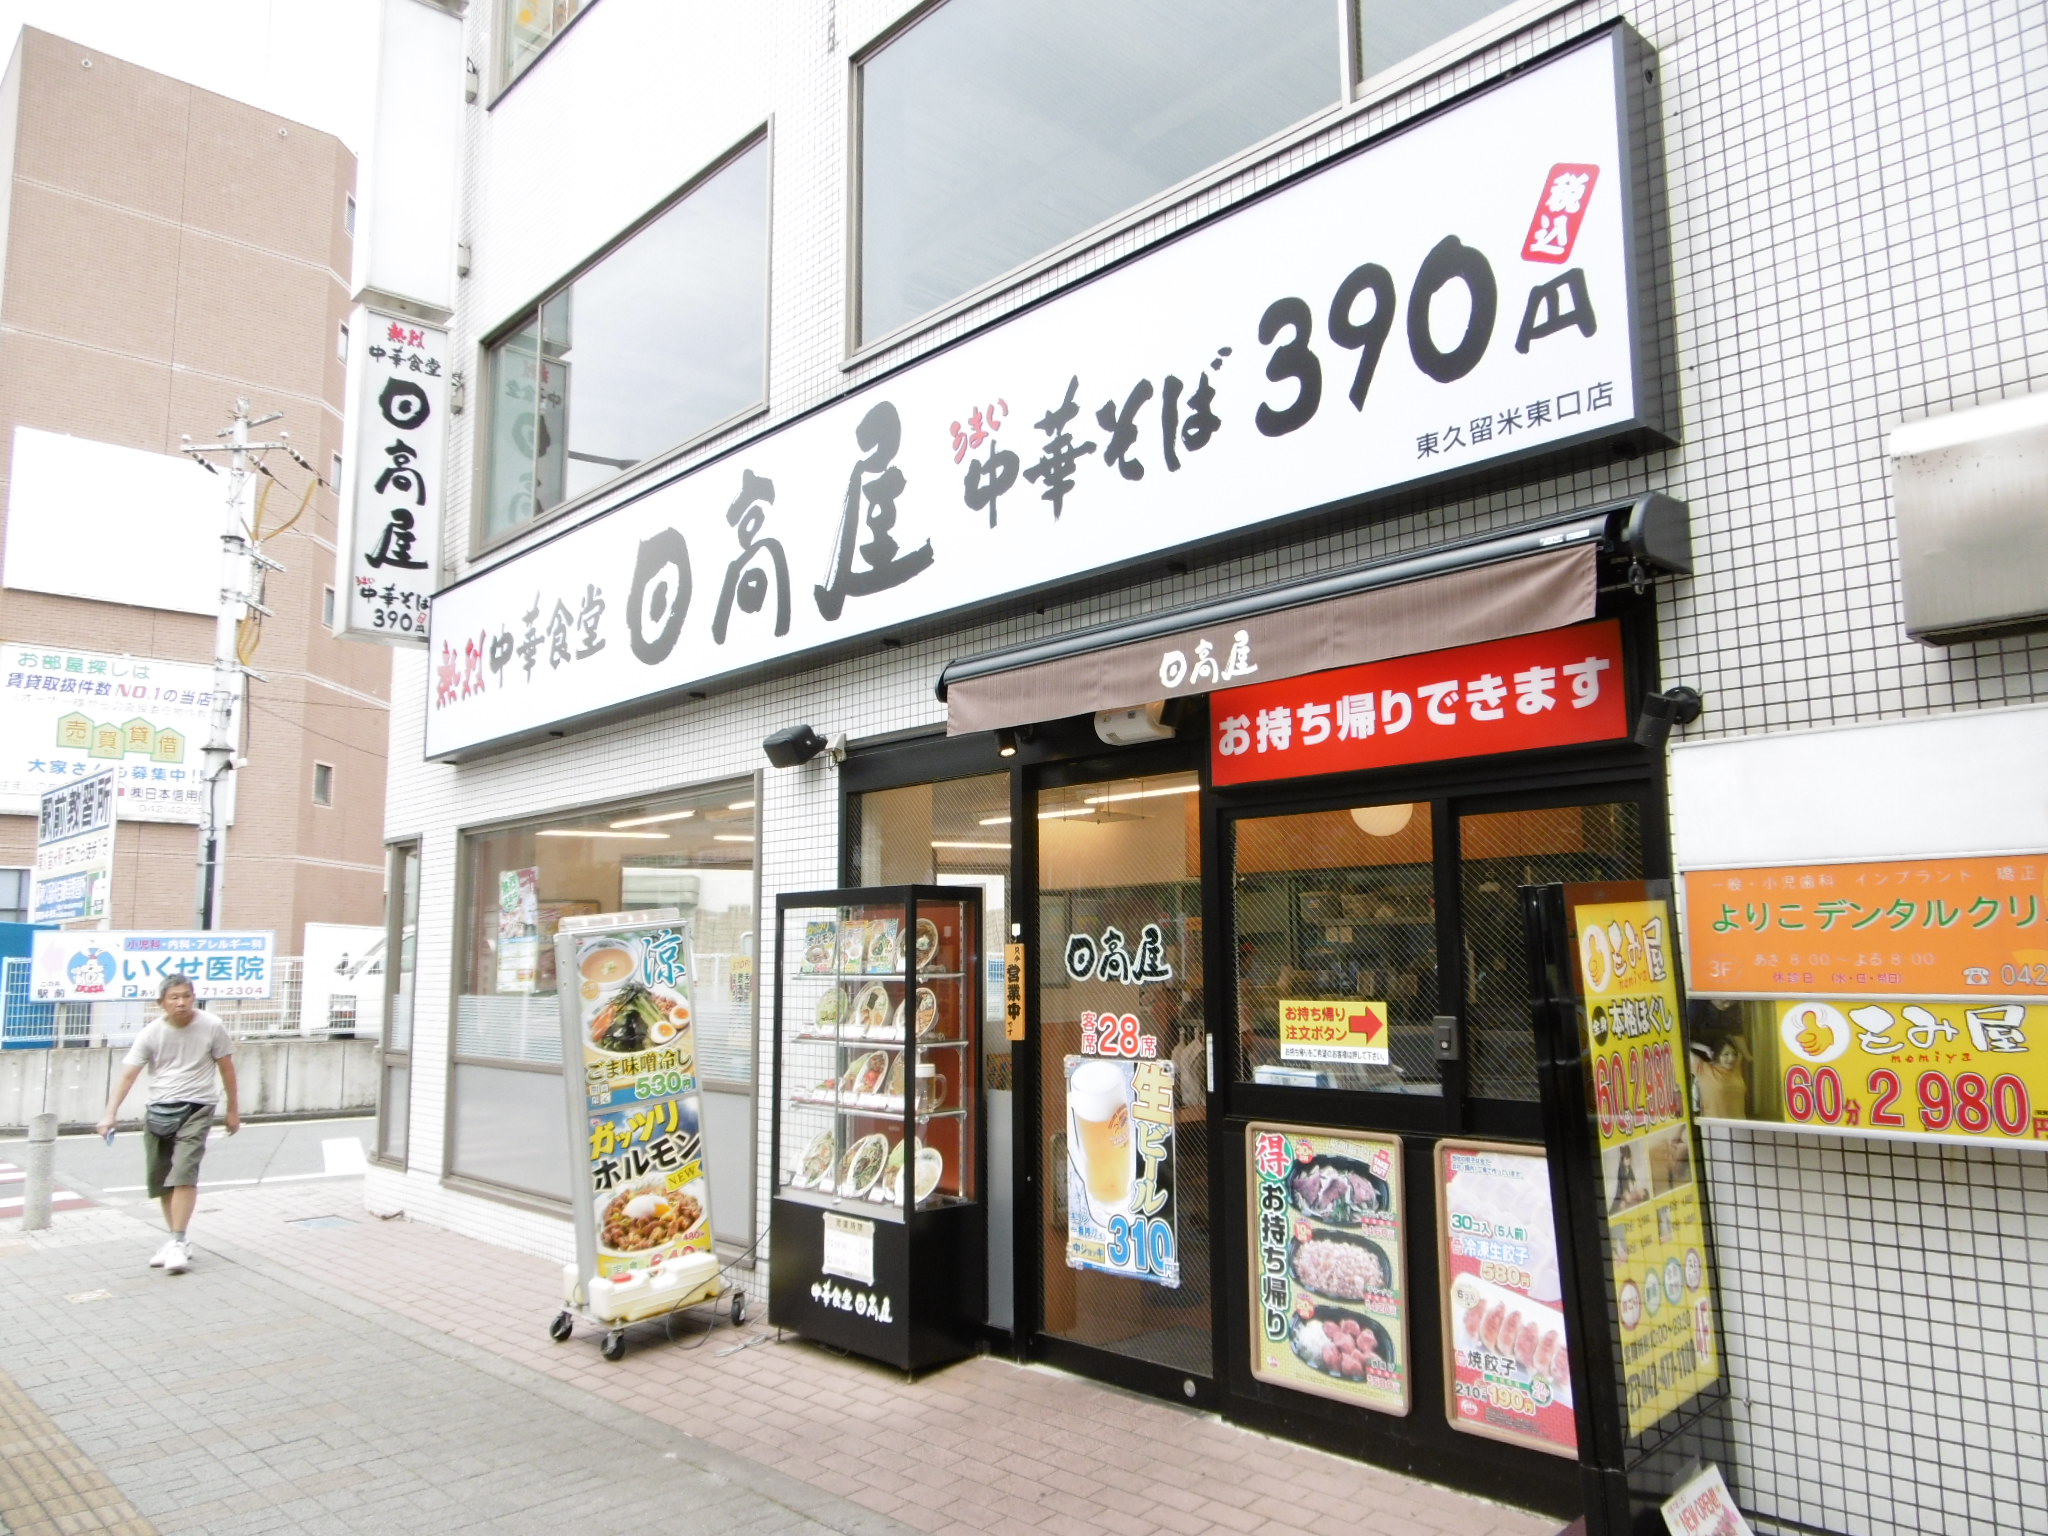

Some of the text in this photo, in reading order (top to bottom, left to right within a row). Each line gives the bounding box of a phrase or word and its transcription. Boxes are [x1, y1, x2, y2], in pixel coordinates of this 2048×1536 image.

[1530, 171, 1587, 259] 税込
[368, 345, 443, 377] 中華食堂
[949, 397, 1009, 464] うまい
[963, 346, 1233, 530] 中華そば
[1416, 380, 1614, 461] 東久留米東口店
[364, 376, 431, 570] 日高屋
[435, 400, 936, 711] 熱烈 中華食堂 日高屋
[18, 652, 150, 680] お部屋探しは
[1158, 630, 1259, 689] 日高屋
[1218, 657, 1612, 757] お持ち帰りできます
[1855, 870, 1974, 886] インプラント
[1996, 865, 2037, 882] 矯正
[1711, 895, 2048, 934] よりこデンタルクリ
[122, 955, 266, 982] いくせ医院
[641, 928, 686, 988] 涼
[1065, 923, 1173, 985] 日高屋
[1709, 960, 1733, 979] 3F
[1006, 964, 1021, 1020] 営業中
[1773, 973, 1814, 985] 休診日
[1081, 1011, 1157, 1058] 客席 28 席
[1284, 1006, 1346, 1022] お持ち帰り
[1285, 1024, 1348, 1041] 注文ボタン
[1608, 995, 1674, 1040] 本格ほぐし
[587, 1048, 693, 1082] ごま味噌冷し
[1891, 1052, 1973, 1064] momiya
[635, 1071, 693, 1100] 530円
[1784, 1063, 1862, 1127] 60分
[589, 1099, 681, 1161] ガッツリ
[1130, 1061, 1176, 1216] 生ビール
[592, 1131, 701, 1191] ホルモン
[668, 1165, 697, 1185] NEW
[1256, 1134, 1290, 1178] 得
[1463, 1237, 1529, 1265] 冷凍生餃子
[1493, 1223, 1528, 1241] (5人前)
[1261, 1183, 1288, 1338] お持ち帰り
[1481, 1261, 1531, 1288] 580円
[811, 1278, 894, 1324] 中華食堂 日高屋
[1467, 1351, 1517, 1377] 焼餃子
[1488, 1387, 1535, 1414] 190円
